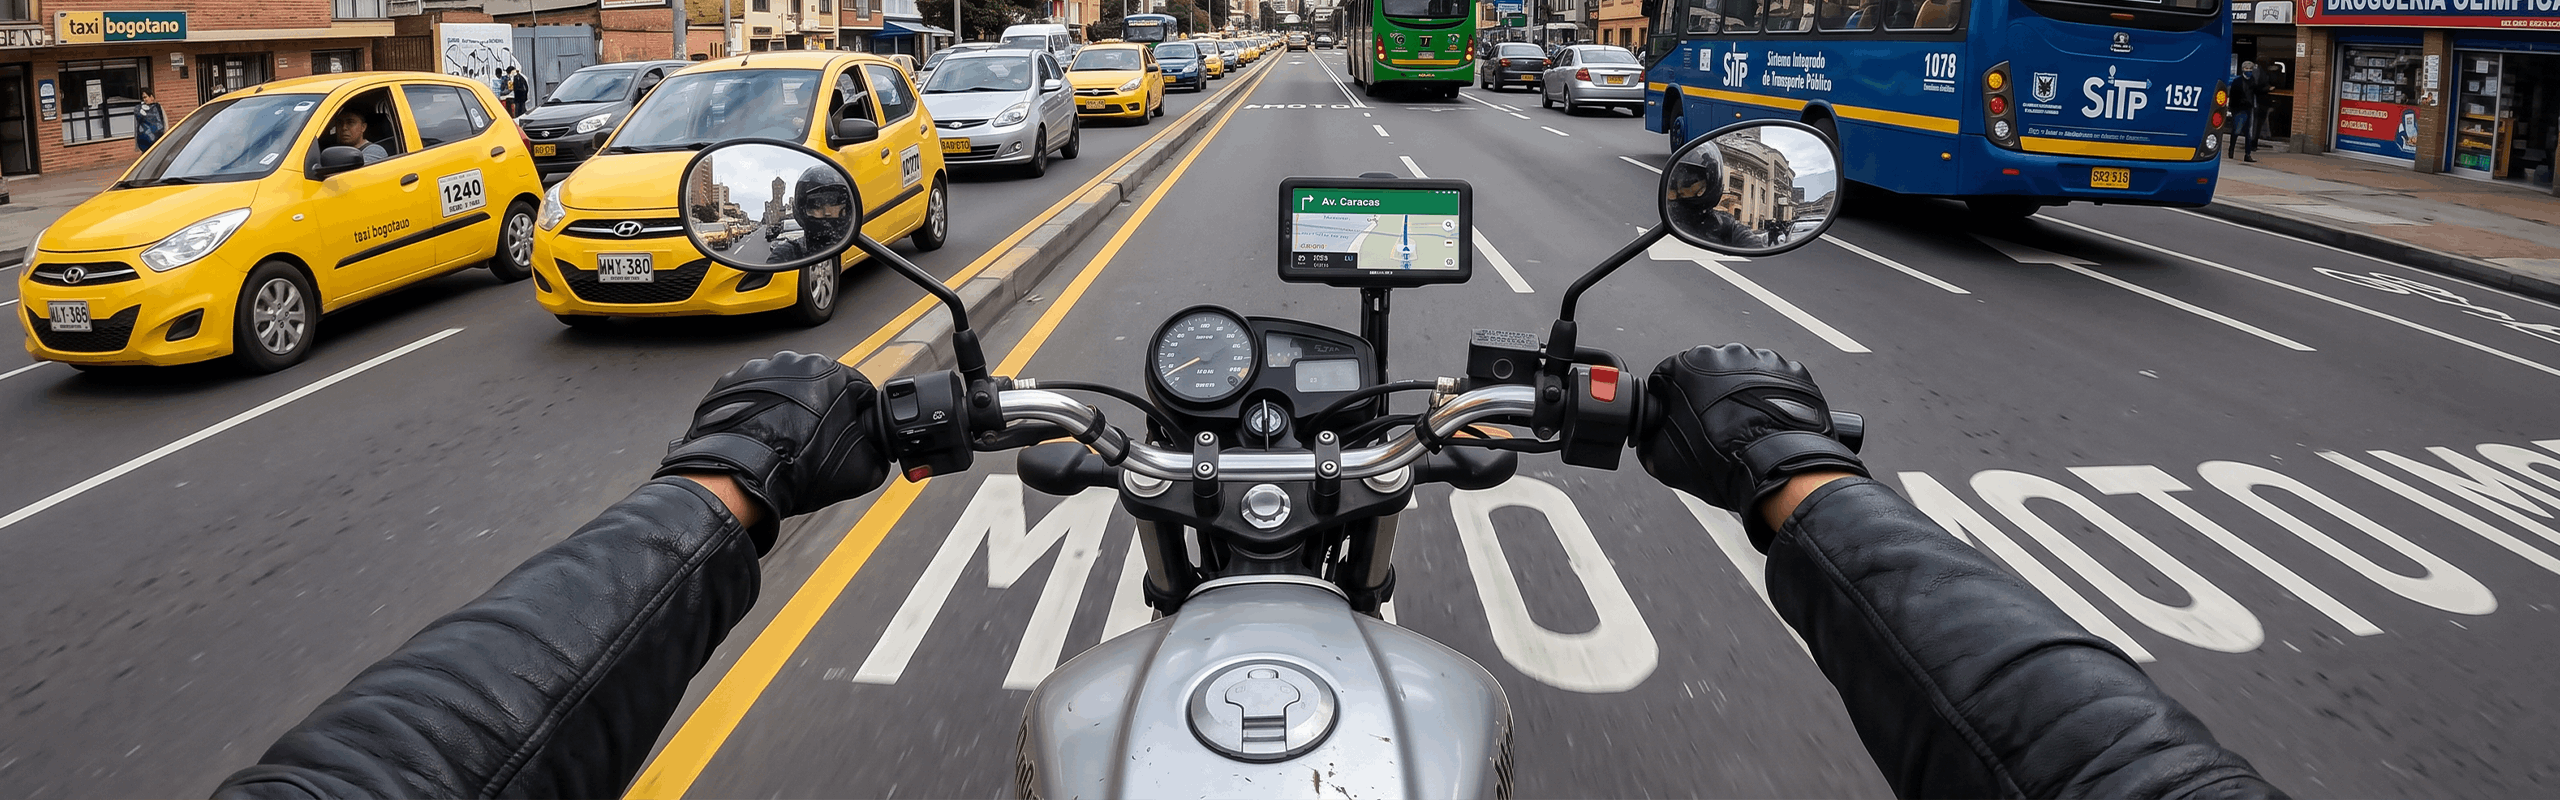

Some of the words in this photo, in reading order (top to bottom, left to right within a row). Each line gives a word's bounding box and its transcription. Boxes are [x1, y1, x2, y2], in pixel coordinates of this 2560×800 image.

[69, 18, 99, 35] taxi
[106, 16, 179, 39] bogotano
[1792, 50, 1826, 73] Integrado
[1924, 52, 1957, 78] 1078
[1762, 69, 1771, 86] de
[1806, 72, 1832, 92] Público
[2165, 83, 2202, 107] 1537
[443, 179, 481, 204] 1240
[1321, 197, 1337, 206] Av.
[1339, 197, 1380, 207] Caracas
